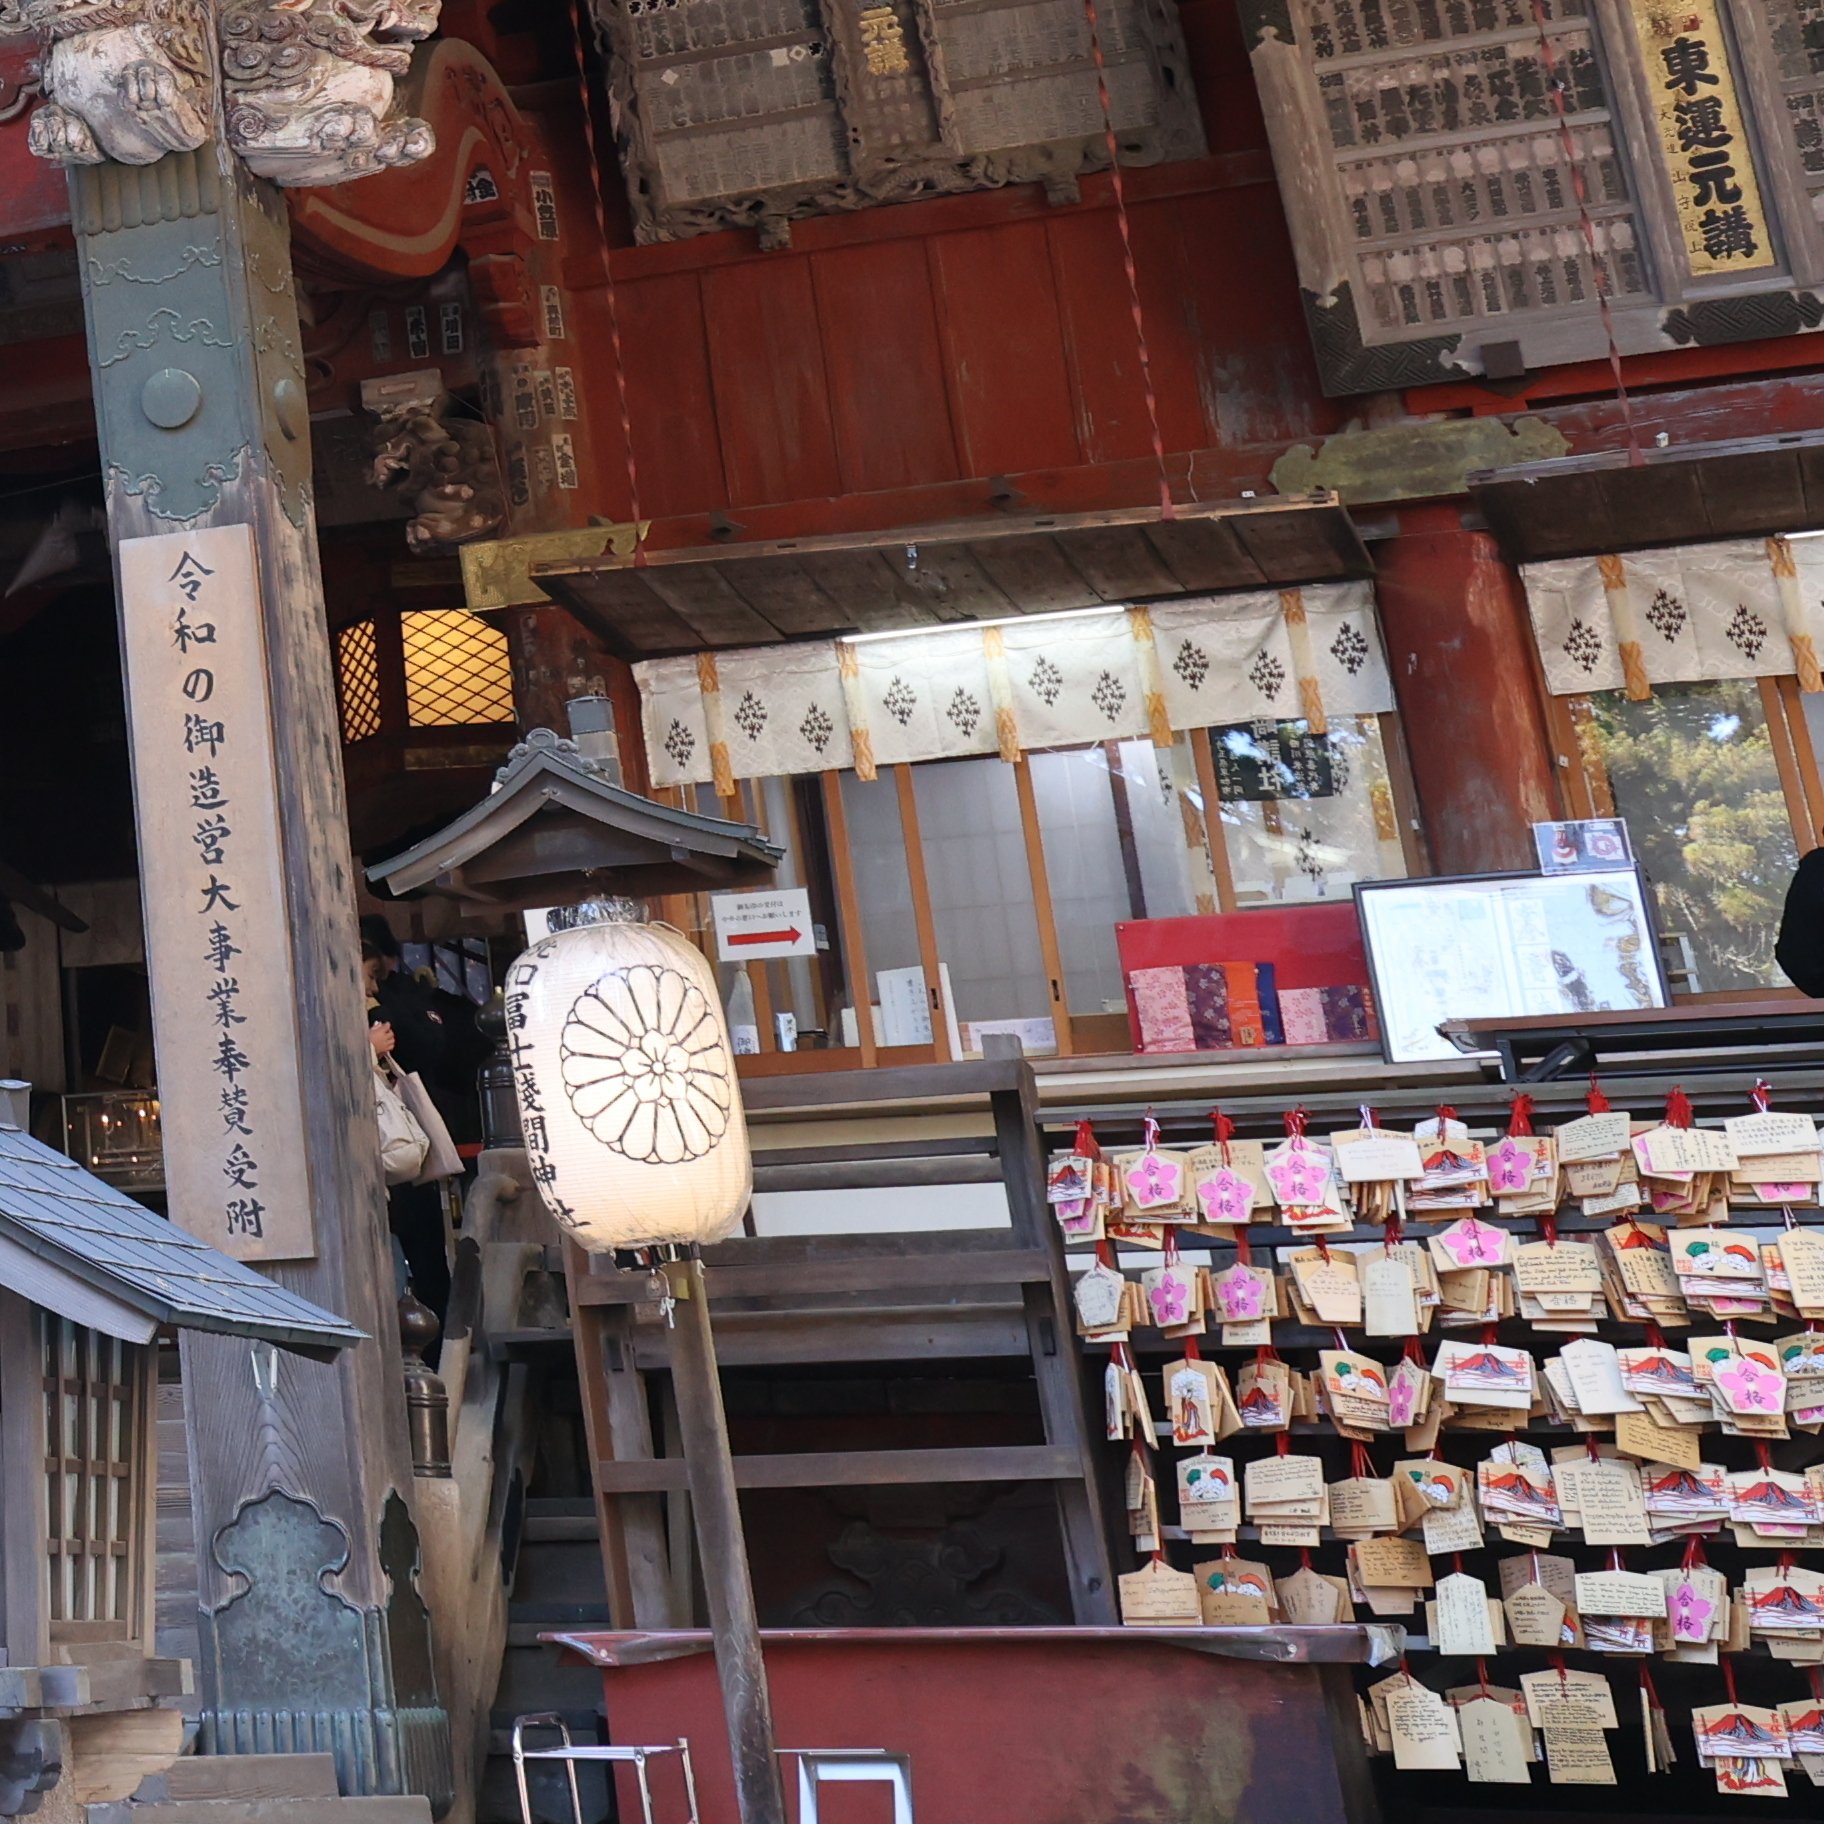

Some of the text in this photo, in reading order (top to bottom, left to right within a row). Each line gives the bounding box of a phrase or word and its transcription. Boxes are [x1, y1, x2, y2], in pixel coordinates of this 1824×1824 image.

[1660, 36, 1758, 261] 東運元講
[167, 550, 266, 1240] 令和の御造営大事業奉賛受附
[1675, 1593, 1694, 1631] 合格
